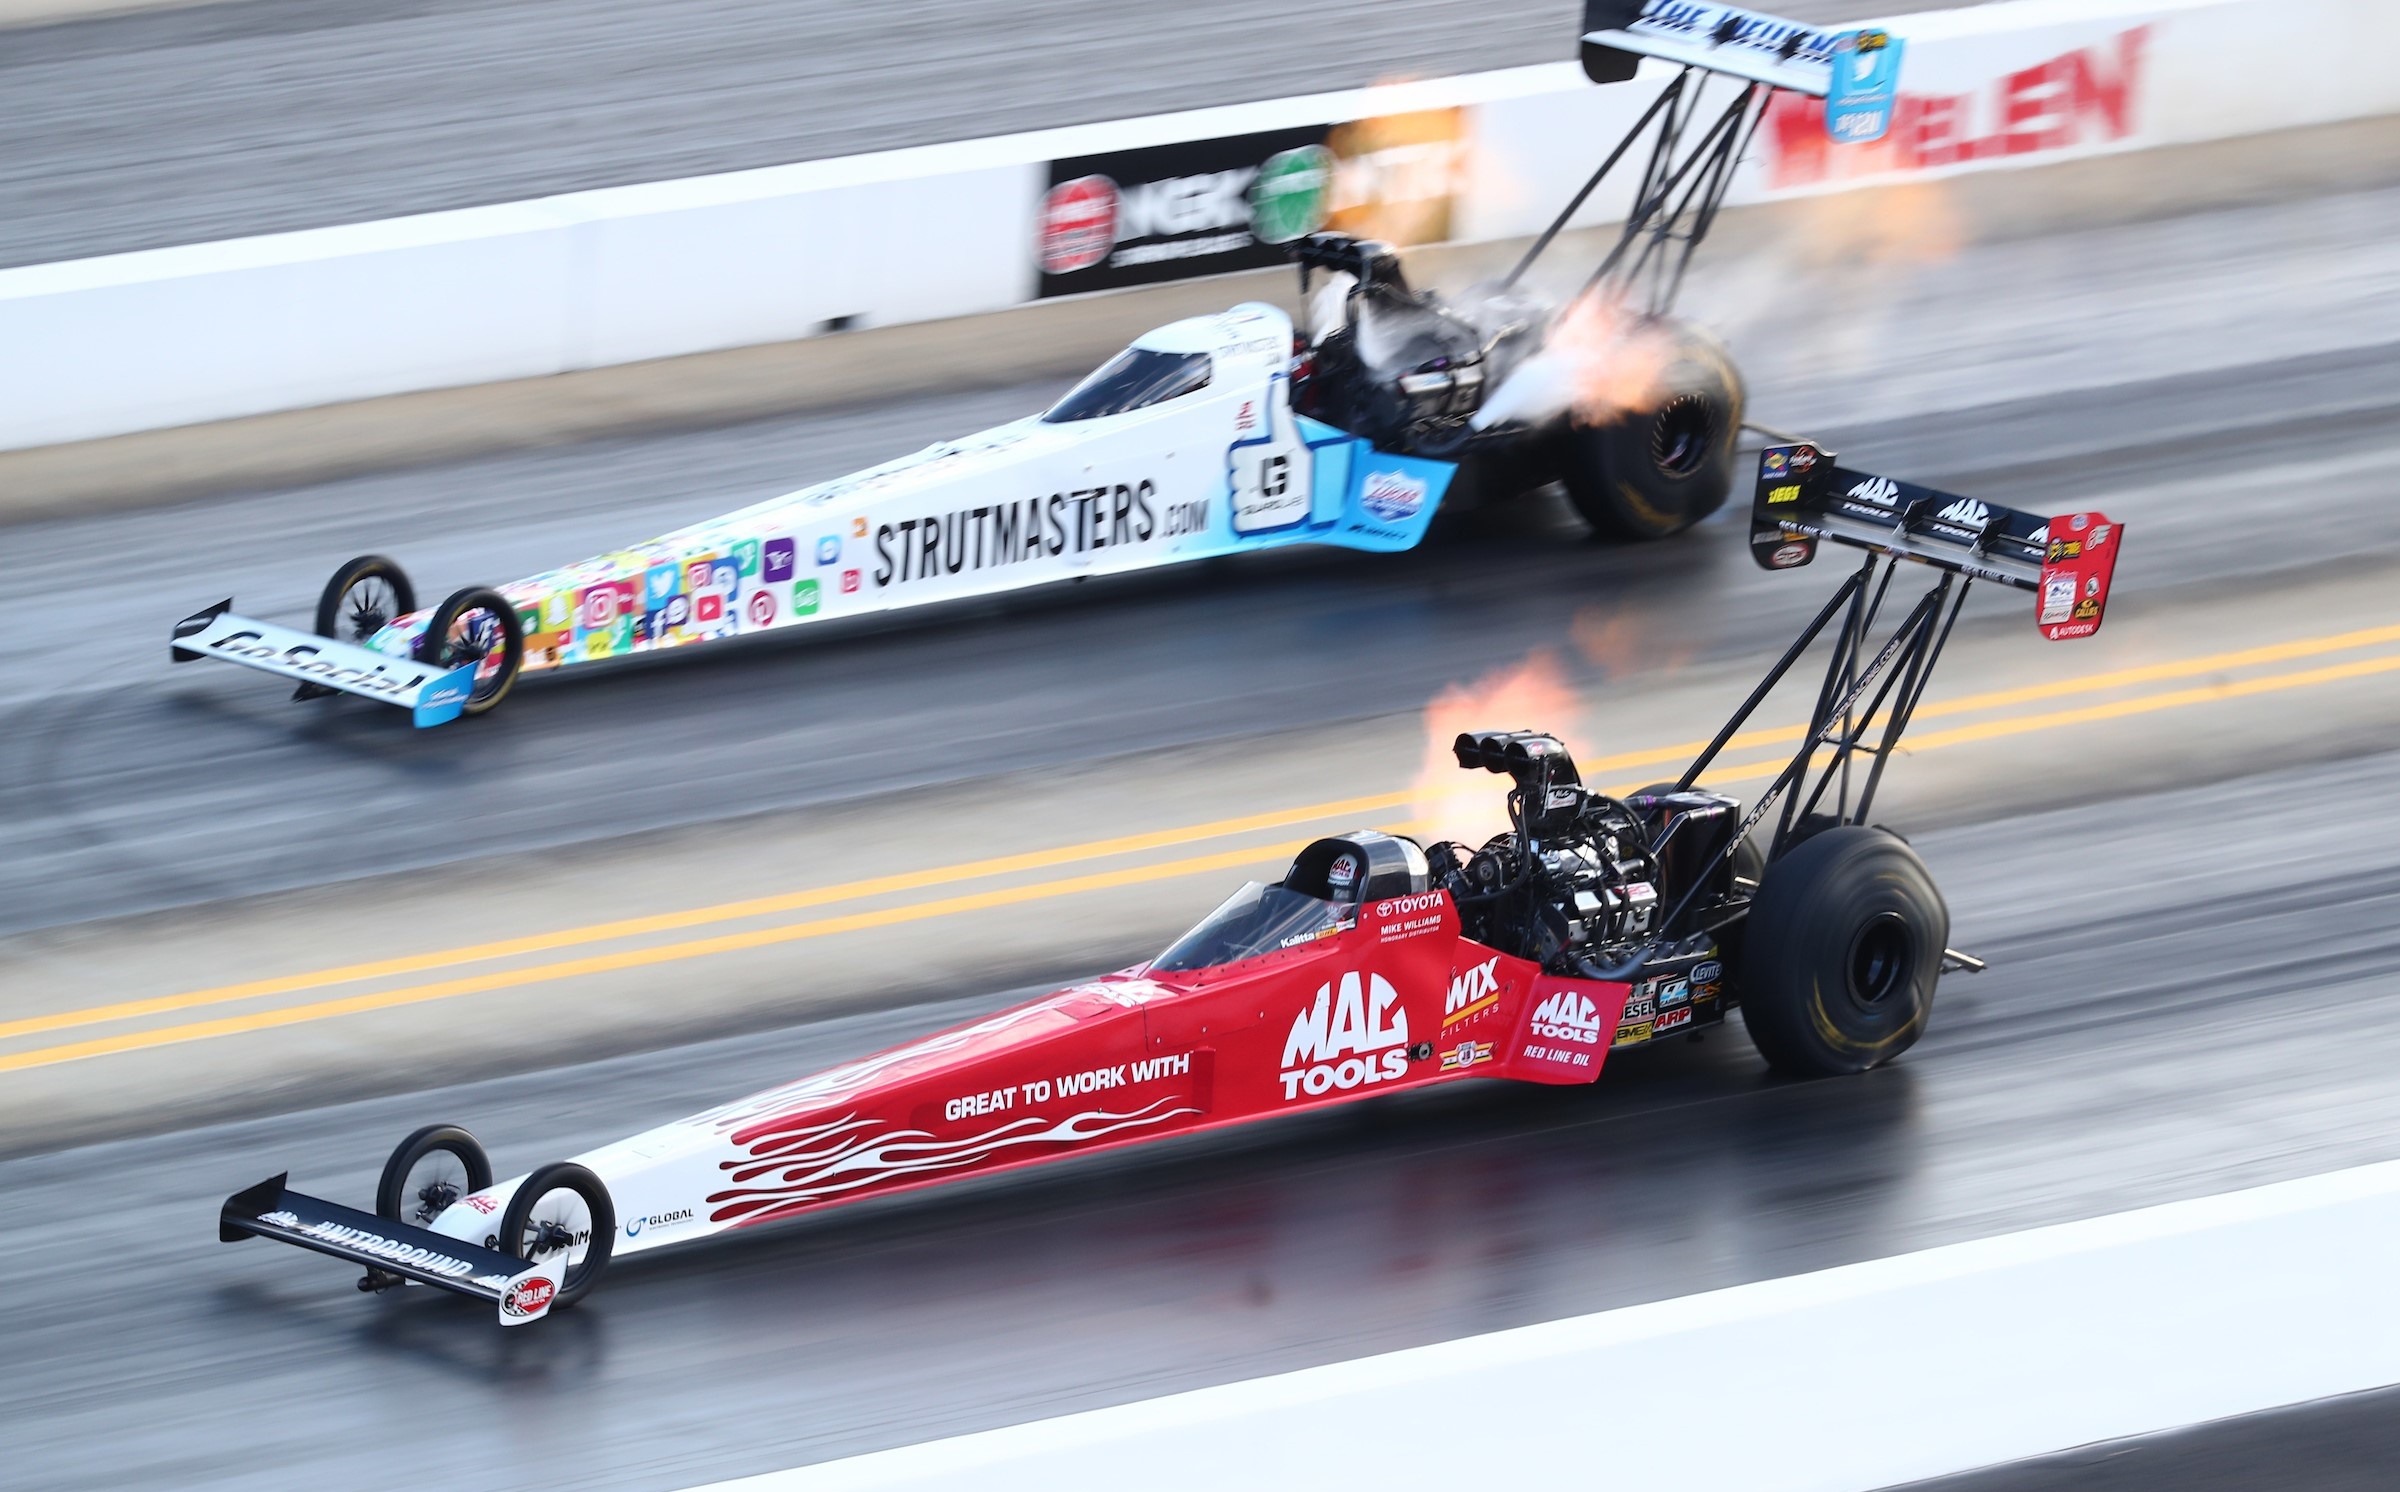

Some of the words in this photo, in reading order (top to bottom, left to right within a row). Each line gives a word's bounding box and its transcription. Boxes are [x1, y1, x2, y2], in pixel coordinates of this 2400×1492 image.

[1754, 22, 2156, 190] WELEN
[1767, 485, 1801, 504] JEGS
[1846, 477, 1899, 507] MAC
[1842, 501, 1894, 519] TOOLS
[1936, 498, 1989, 529] MAC
[1392, 892, 1444, 915] TOYOTA
[1380, 922, 1402, 936] MIKE
[1403, 914, 1442, 931] WILLIAMS
[1280, 932, 1315, 949] Kalitta
[1444, 955, 1499, 1016] WIX
[1281, 971, 1409, 1070] MAC
[1440, 1002, 1500, 1041] FILTERS
[1531, 991, 1600, 1032] MAC
[1654, 1006, 1692, 1029] ARP
[1529, 1022, 1599, 1045] TOOLS
[1523, 1044, 1545, 1058] RED
[1546, 1048, 1571, 1064] LINE
[1572, 1053, 1591, 1067] OIL
[1279, 1047, 1409, 1102] TOOLS
[944, 1087, 1017, 1122] GREAT
[1021, 1079, 1051, 1104] TO
[1056, 1064, 1126, 1098] WORK
[1130, 1053, 1190, 1082] WITH
[649, 1208, 694, 1226] GLOBAL
[516, 1289, 534, 1305] RED
[533, 1284, 552, 1301] LINE
